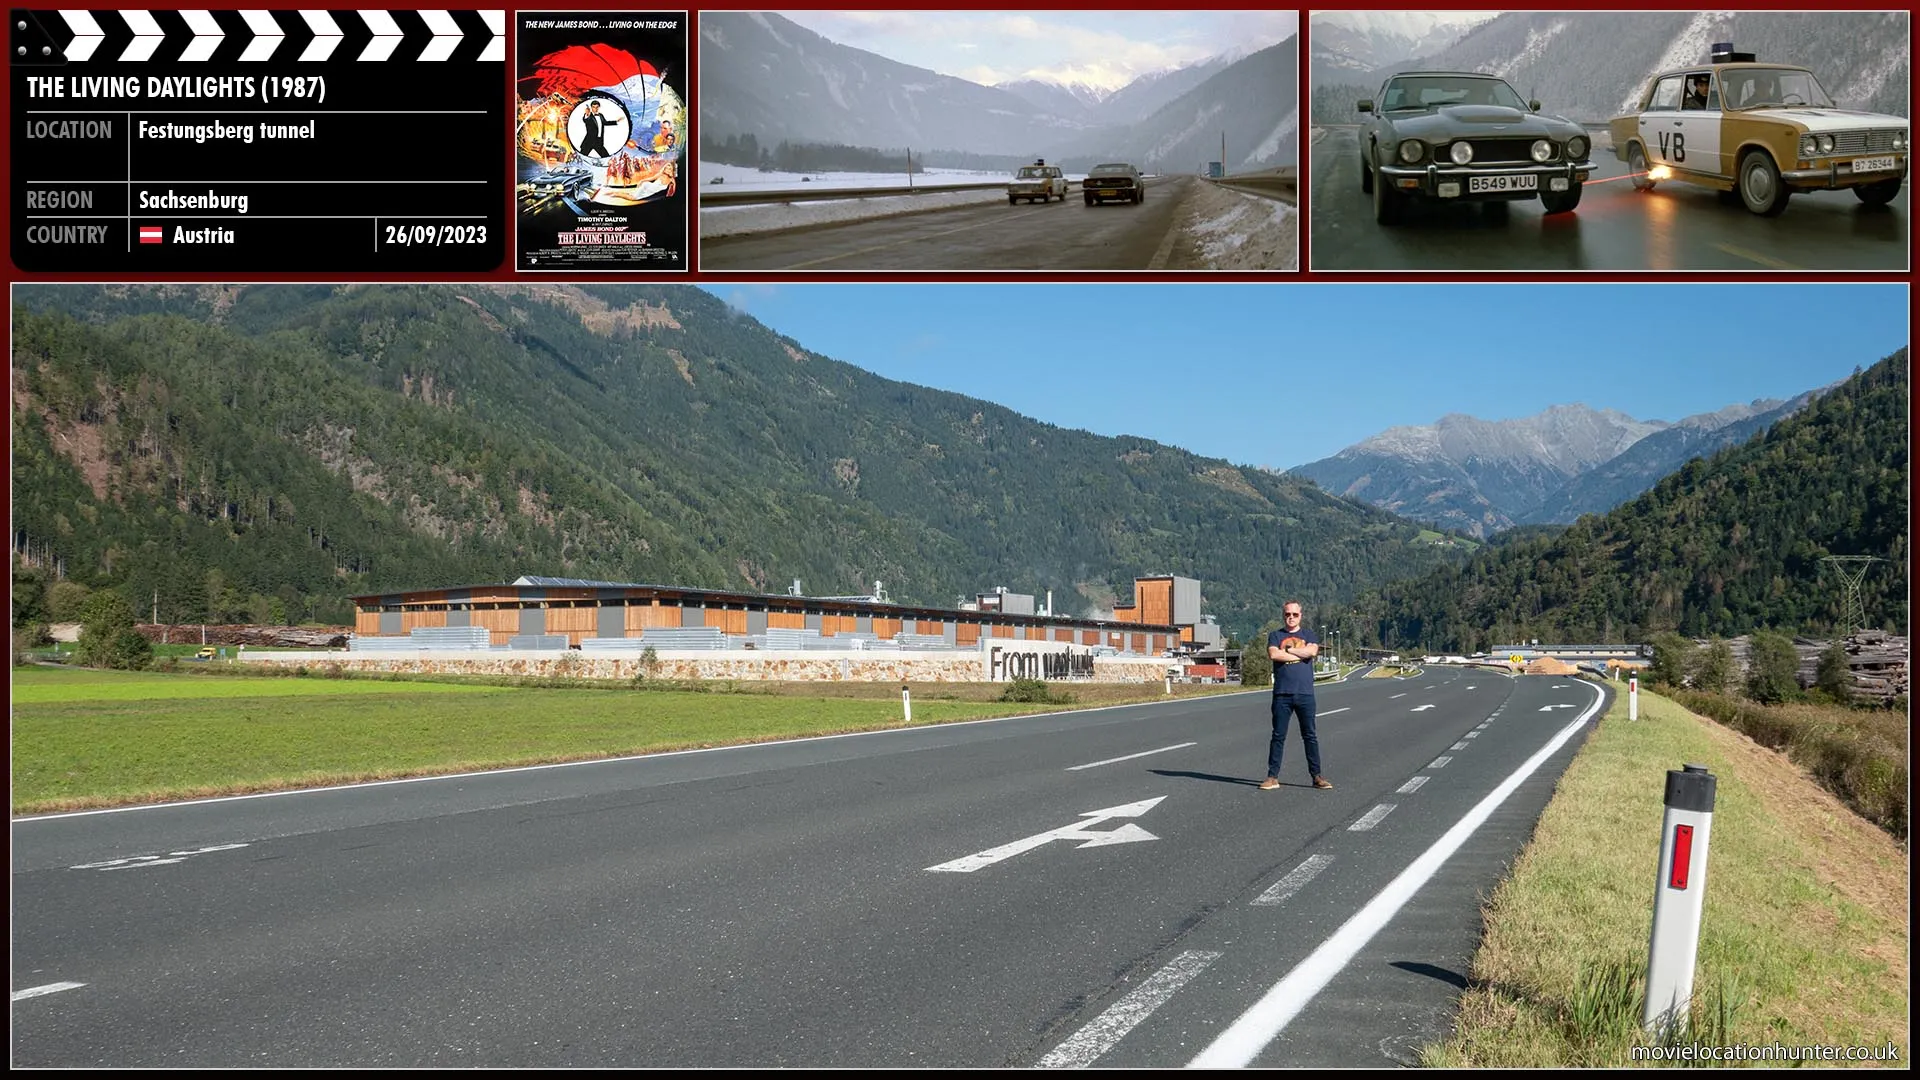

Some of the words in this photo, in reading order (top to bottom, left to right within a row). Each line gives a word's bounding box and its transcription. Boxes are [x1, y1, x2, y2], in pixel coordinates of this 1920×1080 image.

[525, 21, 538, 29] THE
[538, 21, 555, 29] NEW
[555, 21, 578, 29] JAMES
[578, 21, 599, 29] BOND
[608, 21, 632, 29] LIVING
[633, 21, 645, 29] ON
[645, 21, 658, 29] THE
[658, 21, 678, 29] EDGE
[1471, 177, 1507, 190] B549
[1510, 176, 1536, 188] WUU
[558, 233, 575, 244] THE
[575, 233, 603, 244] LIVING
[603, 233, 646, 244] DAYLIGHTS
[990, 646, 1040, 681] From
